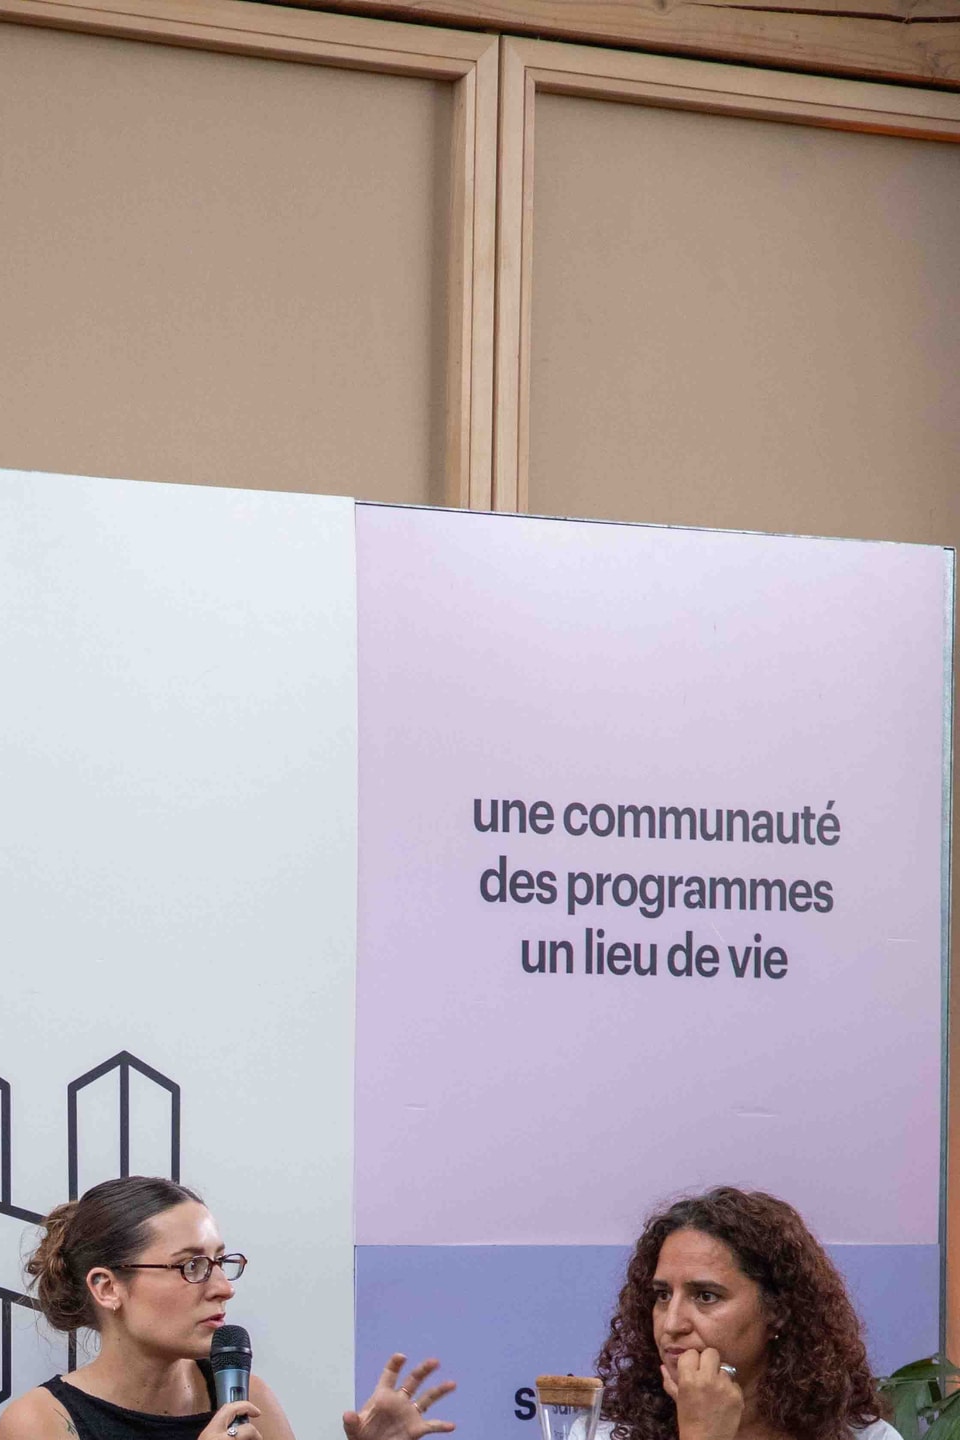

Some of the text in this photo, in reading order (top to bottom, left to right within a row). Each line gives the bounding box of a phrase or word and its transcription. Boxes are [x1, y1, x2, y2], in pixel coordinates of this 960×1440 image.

[473, 798, 841, 846] une communauté
[479, 855, 834, 918] des programmes
[521, 928, 788, 980] un lieu de vie
